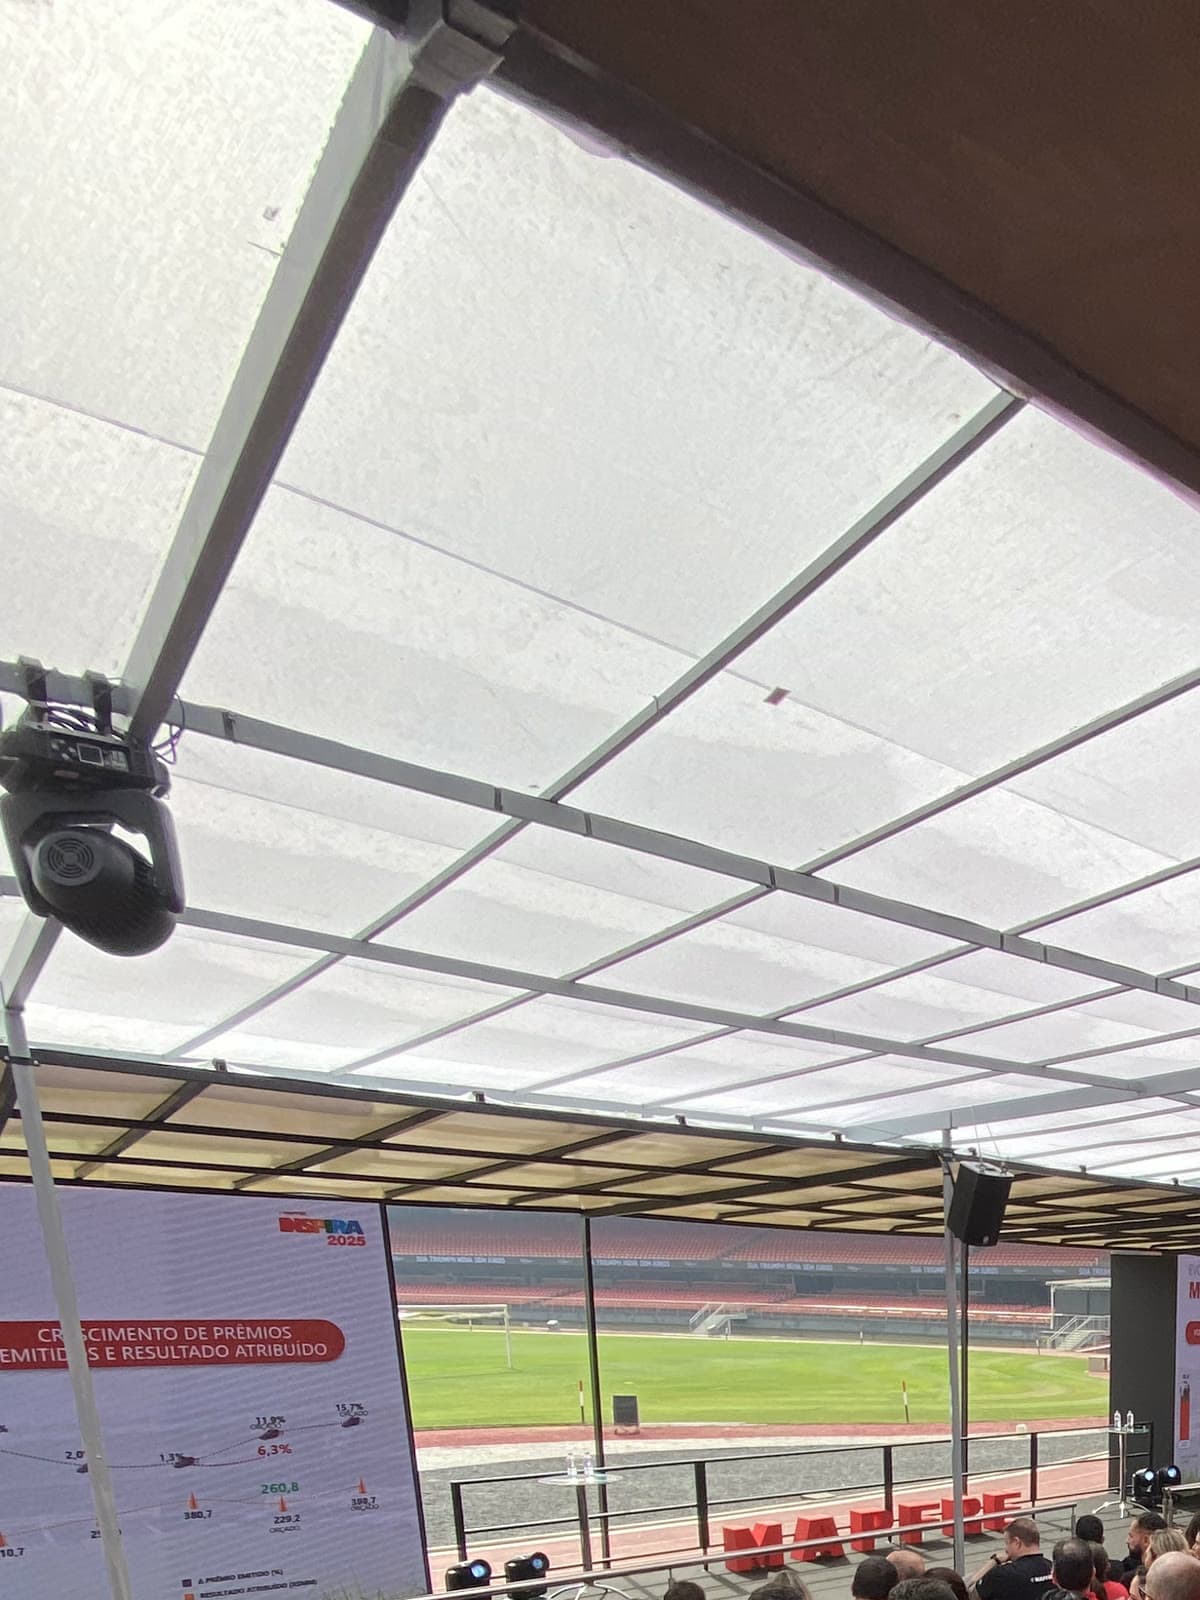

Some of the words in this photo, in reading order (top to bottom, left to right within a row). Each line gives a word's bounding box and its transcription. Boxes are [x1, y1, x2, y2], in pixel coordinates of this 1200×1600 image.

[327, 1235, 366, 1246] 2025
[38, 1327, 178, 1343] CRSCIMENTO
[184, 1326, 209, 1341] DE
[213, 1323, 292, 1340] PRÊMIOS
[0, 1347, 99, 1363] EMITIDS
[106, 1347, 117, 1361] E
[122, 1345, 229, 1361] RESULTADO
[235, 1340, 327, 1357] ATRIBUÍDO
[65, 1450, 86, 1460] 2,0
[257, 1444, 292, 1456] 6,3%
[261, 1482, 299, 1494] 260,8
